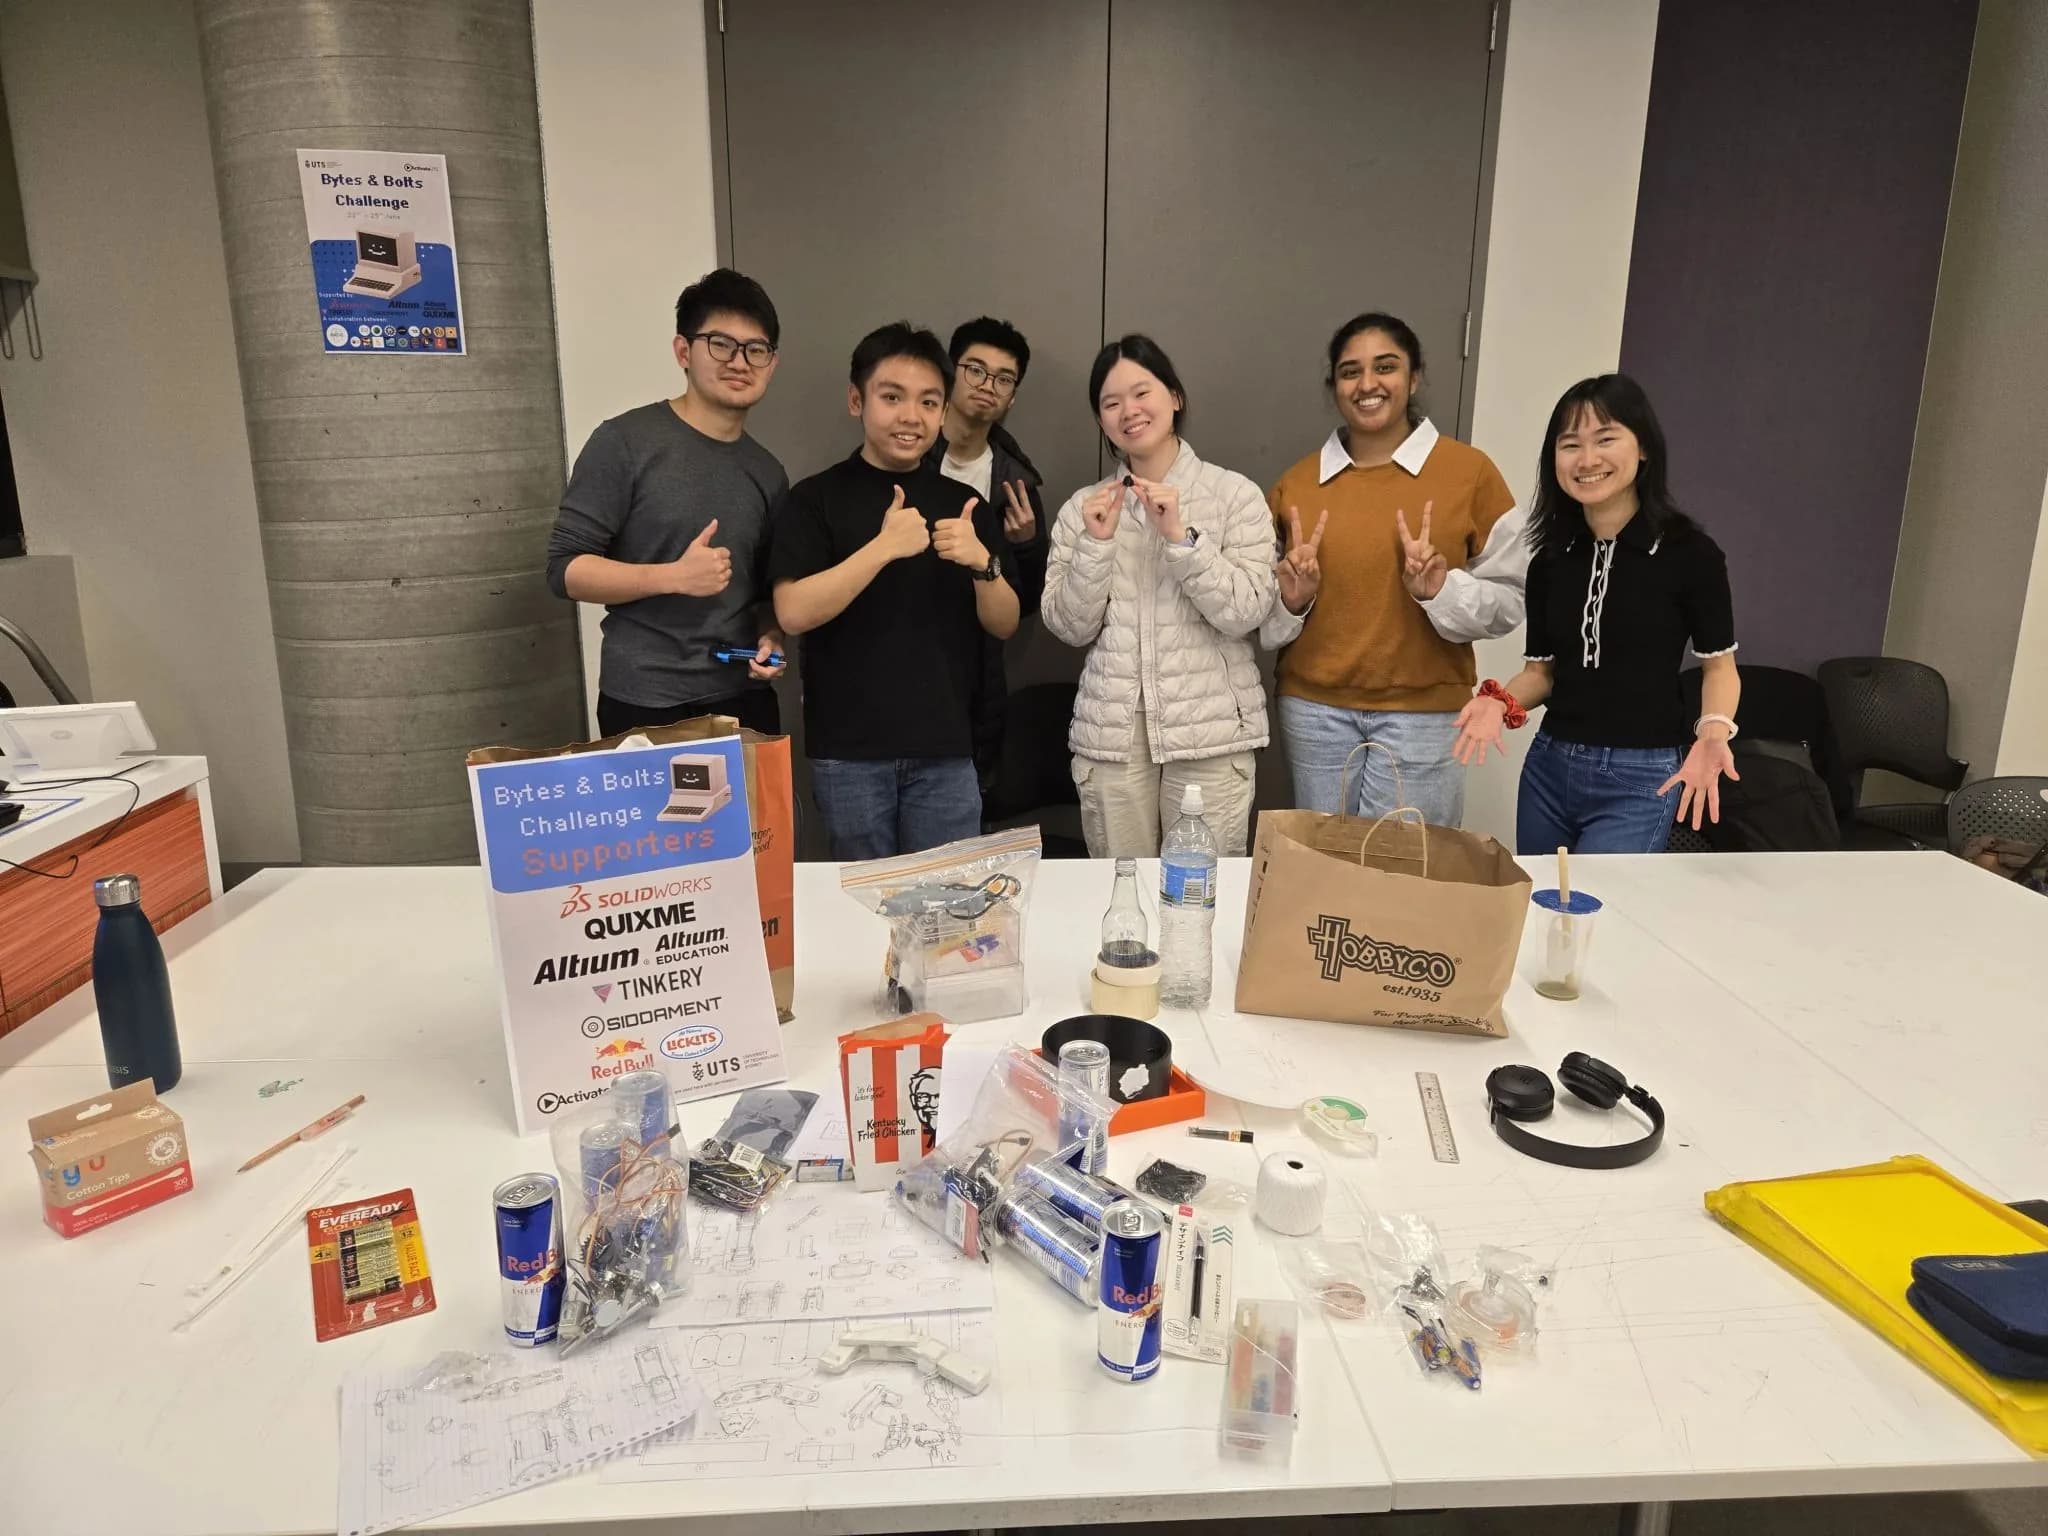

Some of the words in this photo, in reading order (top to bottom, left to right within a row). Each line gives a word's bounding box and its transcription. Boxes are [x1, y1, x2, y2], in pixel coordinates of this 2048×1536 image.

[311, 161, 326, 169] UTS
[321, 173, 362, 188] Bytes
[367, 174, 379, 186] &
[383, 175, 423, 189] Bolts
[335, 194, 409, 210] Challenge
[494, 783, 566, 808] Bytes
[576, 776, 594, 795] &
[602, 769, 665, 791] Bolts
[520, 806, 643, 837] Challenge
[522, 828, 715, 876] Supporters
[598, 877, 713, 909] SOLIDWORKS
[584, 901, 697, 941] QUIXME
[655, 927, 726, 953] Altium
[656, 944, 730, 965] EDUCATION
[533, 947, 640, 986] Altium
[617, 966, 703, 1000] TINKERY
[1383, 983, 1443, 1003] est.1935
[607, 996, 722, 1032] SIDDAMENT
[666, 1032, 717, 1051] LICKITS
[591, 1060, 623, 1080] Red
[624, 1054, 654, 1075] Bull
[707, 1057, 741, 1077] UTS
[858, 1130, 880, 1142] Fried
[882, 1127, 916, 1138] Chicken
[866, 1117, 906, 1131] Kentucky
[66, 1180, 106, 1201] Cotton
[108, 1172, 131, 1187] Tips
[310, 1208, 333, 1217] AAA
[319, 1200, 404, 1229] EVEREADY
[323, 1220, 363, 1233] GOLD
[507, 1251, 544, 1272] Red
[1113, 1285, 1149, 1304] Red
